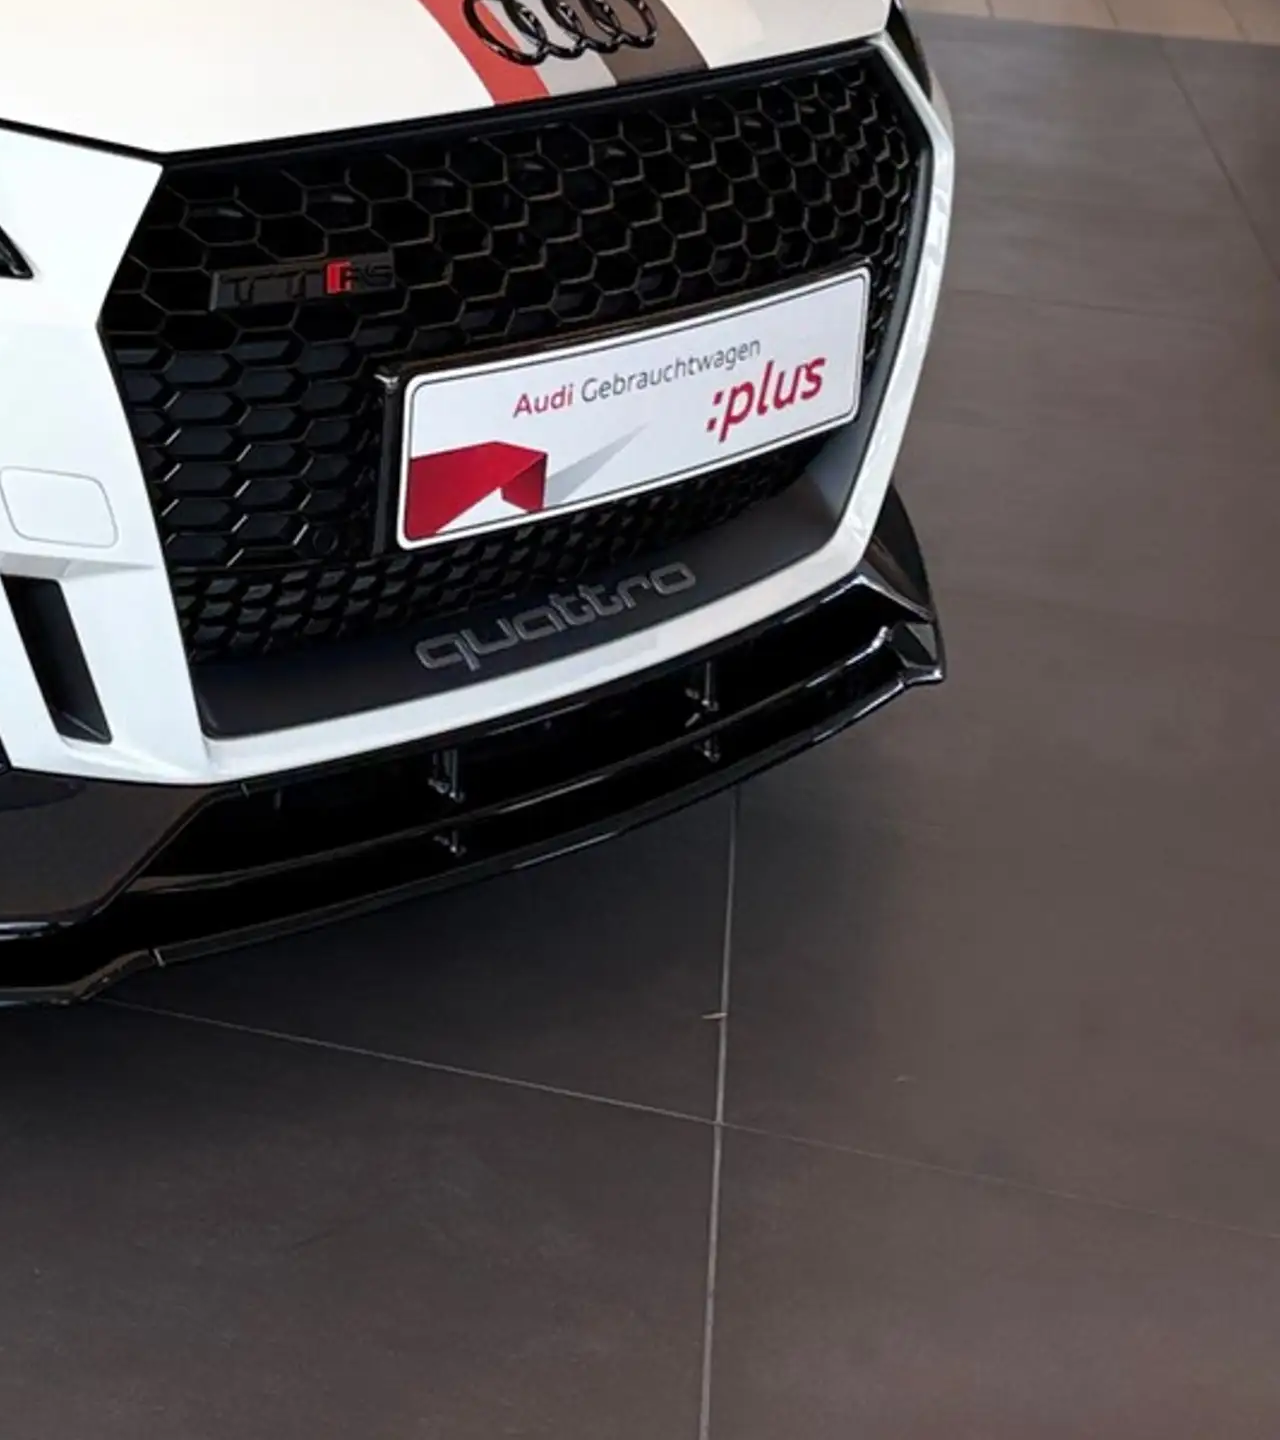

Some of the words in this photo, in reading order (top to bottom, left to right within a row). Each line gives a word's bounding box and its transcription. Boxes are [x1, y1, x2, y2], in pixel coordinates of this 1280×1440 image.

[512, 382, 575, 420] Audi
[580, 338, 762, 403] Gebrauchtwagen
[414, 561, 697, 673] quattro
